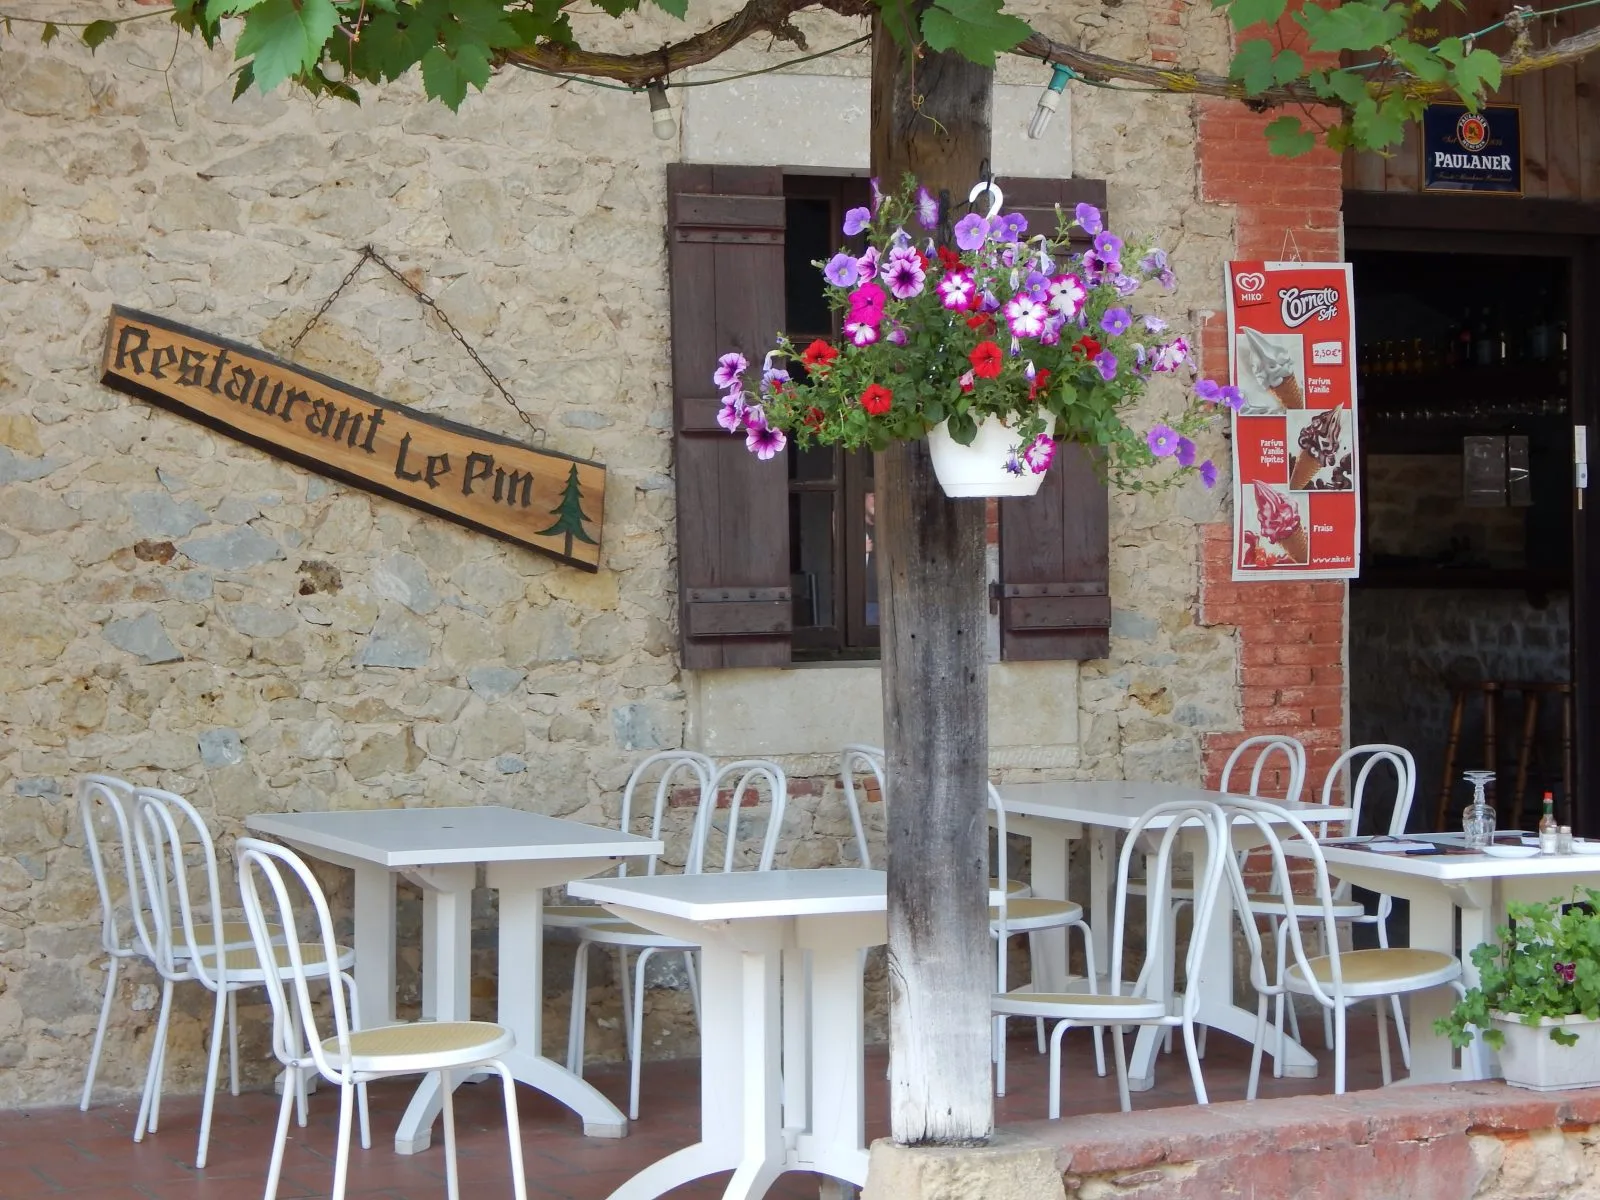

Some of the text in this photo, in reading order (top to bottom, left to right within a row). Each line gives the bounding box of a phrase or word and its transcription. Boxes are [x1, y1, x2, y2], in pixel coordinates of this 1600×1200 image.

[1434, 151, 1512, 171] PAULANER
[1241, 293, 1262, 301] MIKO
[1278, 287, 1339, 328] Cornetto
[1317, 305, 1338, 321] Soft
[1308, 377, 1331, 386] Parfum
[1309, 385, 1330, 394] Vanille
[114, 324, 535, 508] Restaurant Le Pin
[1260, 439, 1284, 447] Parfum
[1263, 447, 1284, 455] Vanille
[1313, 523, 1334, 533] Fraise
